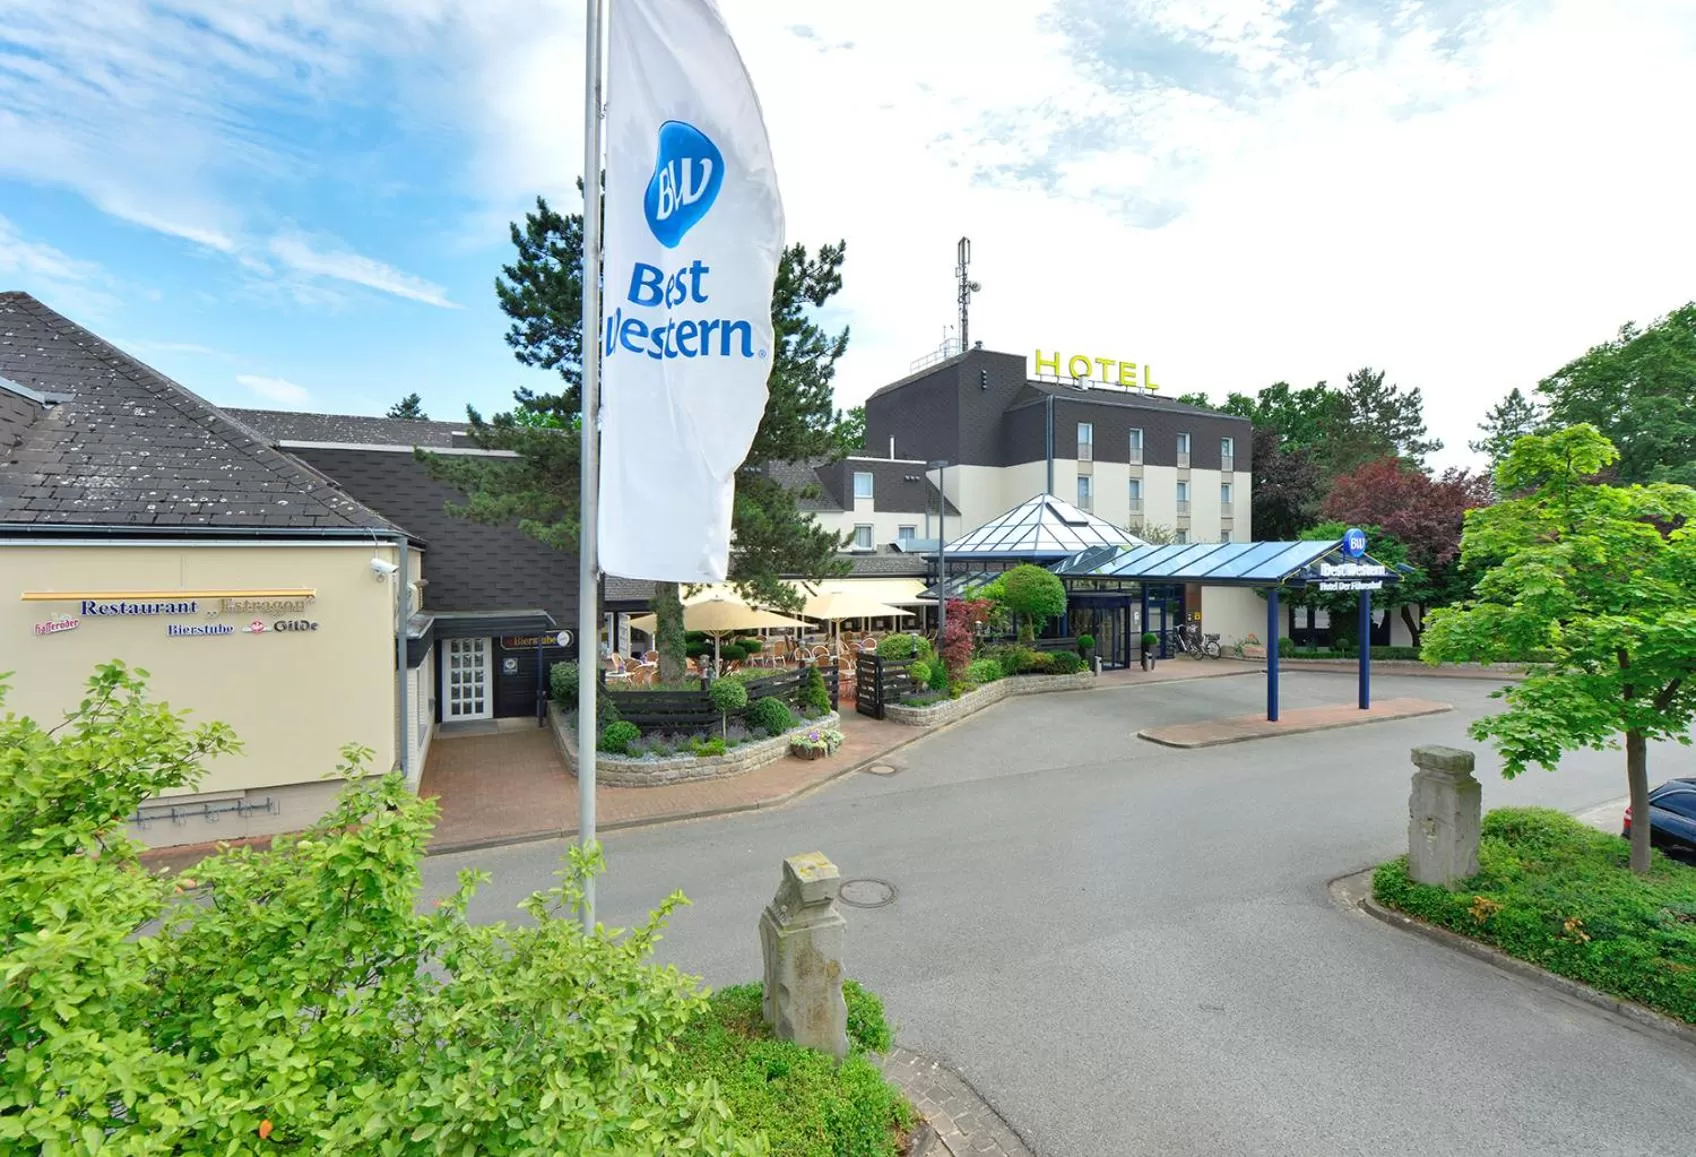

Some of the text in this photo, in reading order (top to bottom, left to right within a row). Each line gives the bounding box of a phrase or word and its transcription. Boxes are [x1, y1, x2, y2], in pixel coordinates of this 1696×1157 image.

[656, 157, 713, 221] BW
[627, 260, 710, 309] Best
[1035, 349, 1160, 390] HOTEL
[81, 600, 198, 616] Restaurant
[168, 624, 233, 636] Bierstube
[273, 619, 319, 633] Gilde
[513, 636, 557, 646] Biersube
